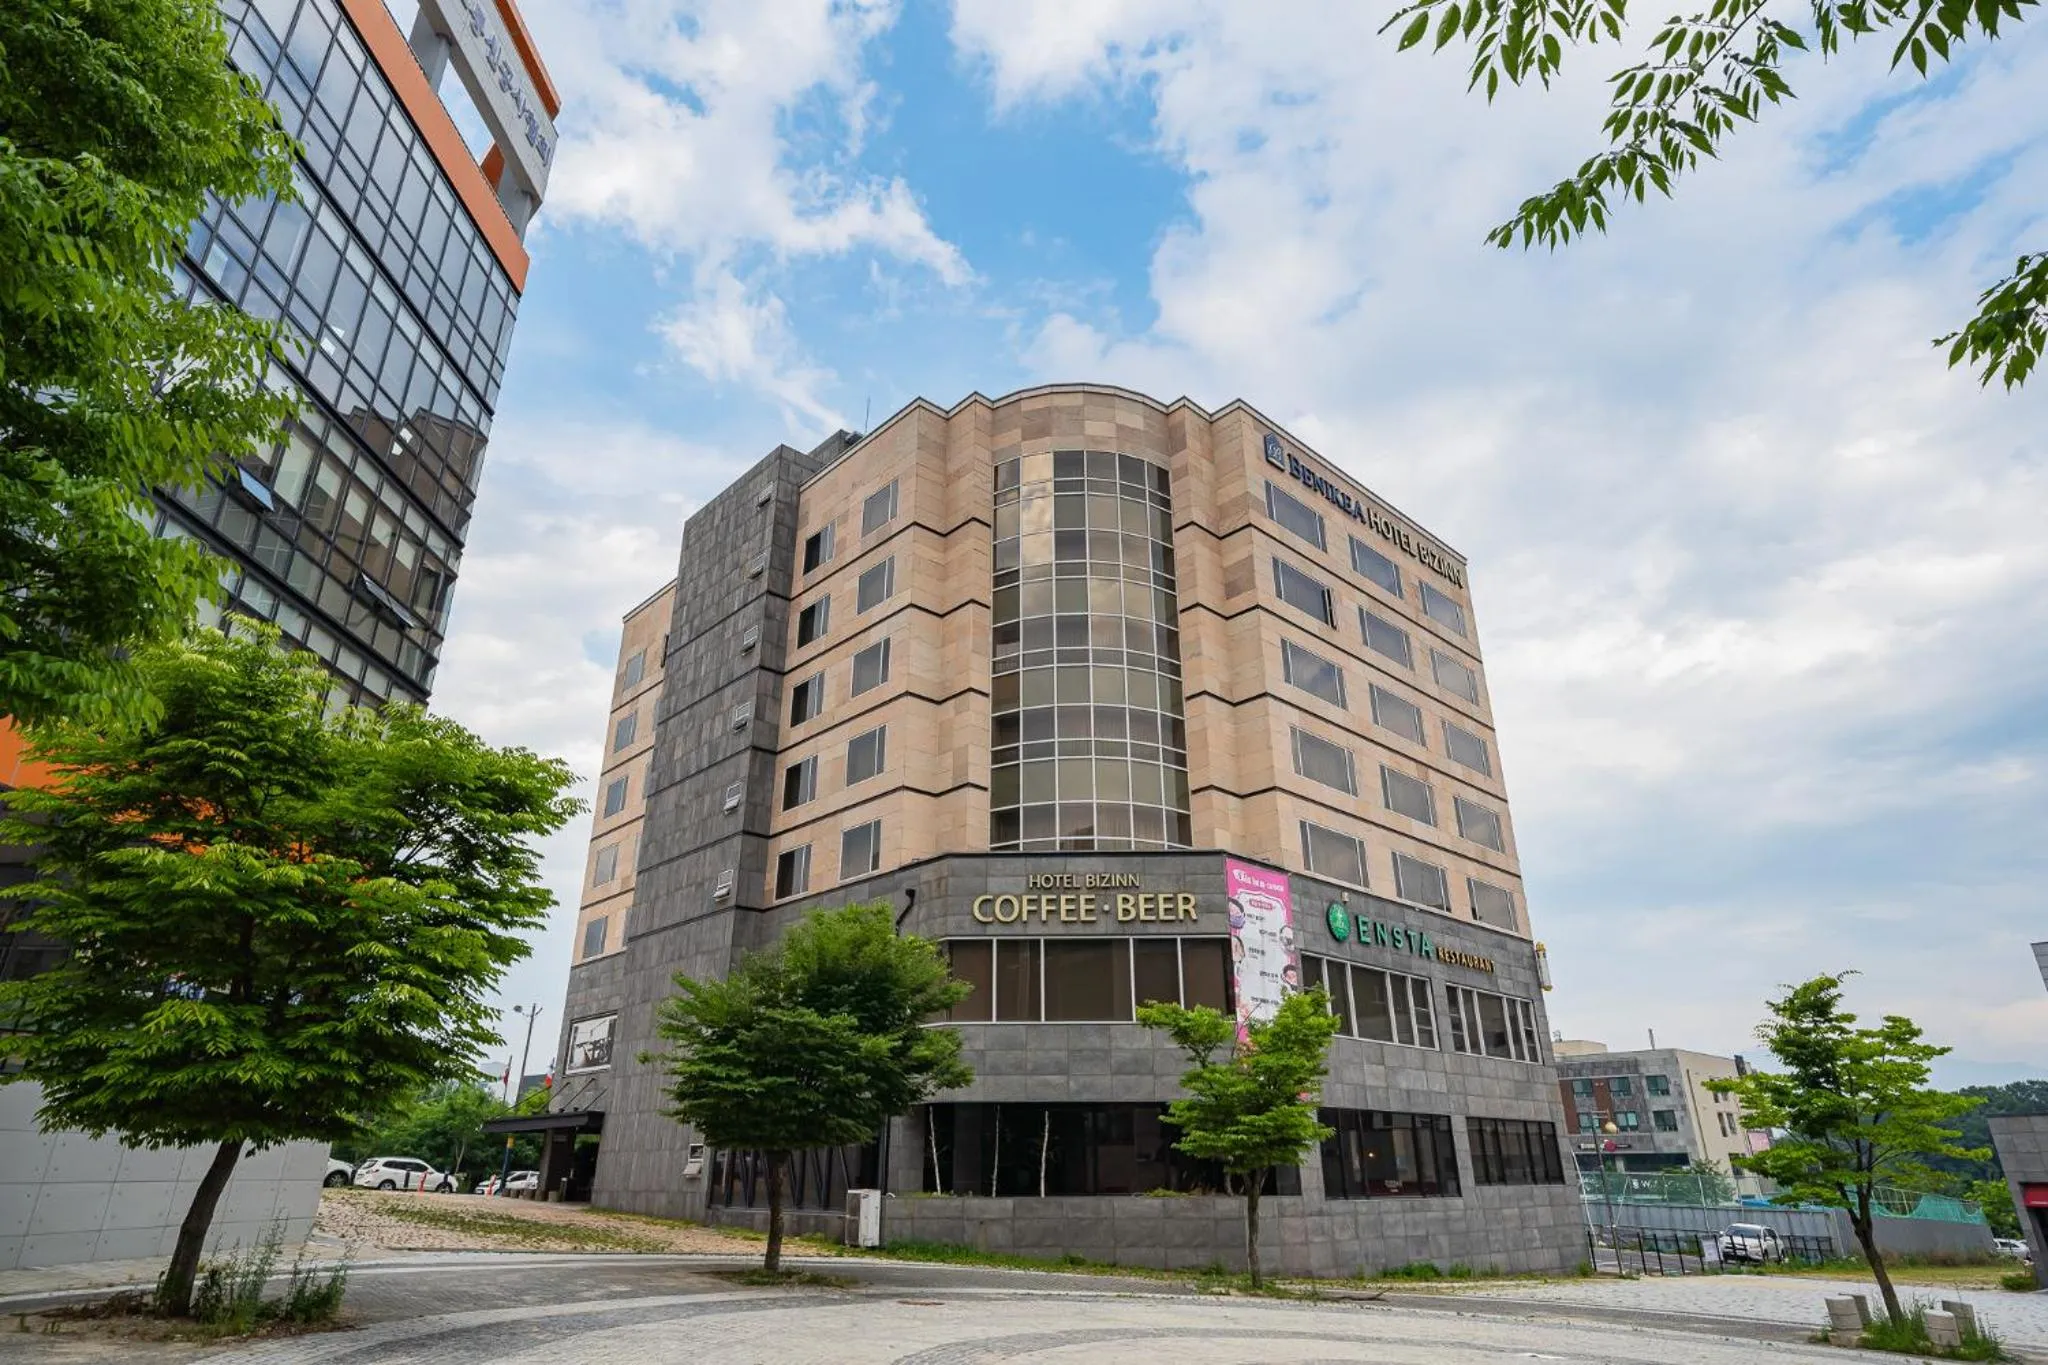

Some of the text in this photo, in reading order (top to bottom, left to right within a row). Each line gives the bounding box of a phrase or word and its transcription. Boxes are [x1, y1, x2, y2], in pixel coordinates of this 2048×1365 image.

[1287, 452, 1463, 589] BENIKEA HOTEL BIZINN
[1029, 873, 1141, 889] HOTEL BIZINN
[972, 894, 1097, 923] COFFEE
[1116, 893, 1198, 922] BEER
[1356, 915, 1496, 975] ENSTA RESTAURANT
